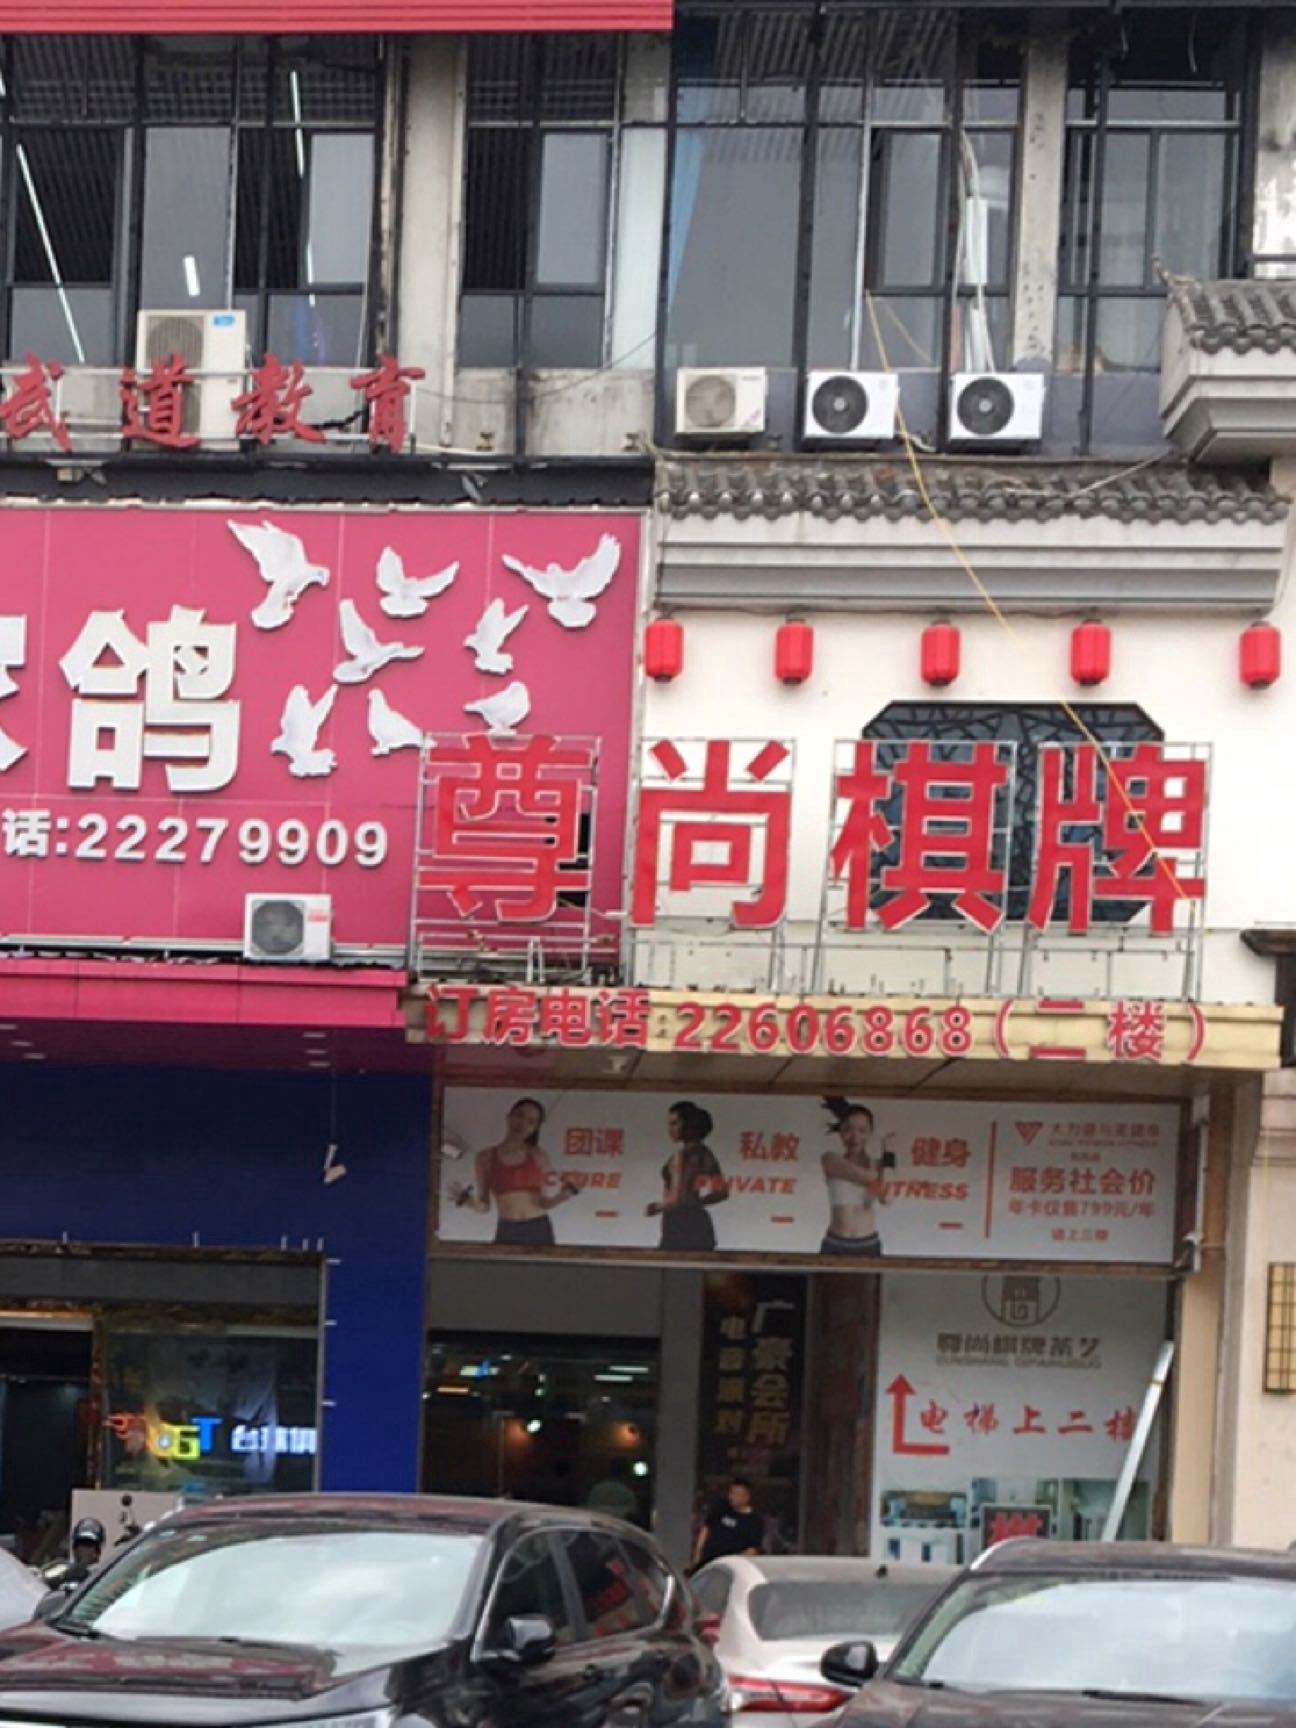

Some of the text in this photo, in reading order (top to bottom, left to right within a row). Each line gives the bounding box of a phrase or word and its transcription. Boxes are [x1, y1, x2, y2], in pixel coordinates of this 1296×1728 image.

[417, 732, 1208, 936] 尊尚棋牌
[910, 1137, 971, 1168] 健身
